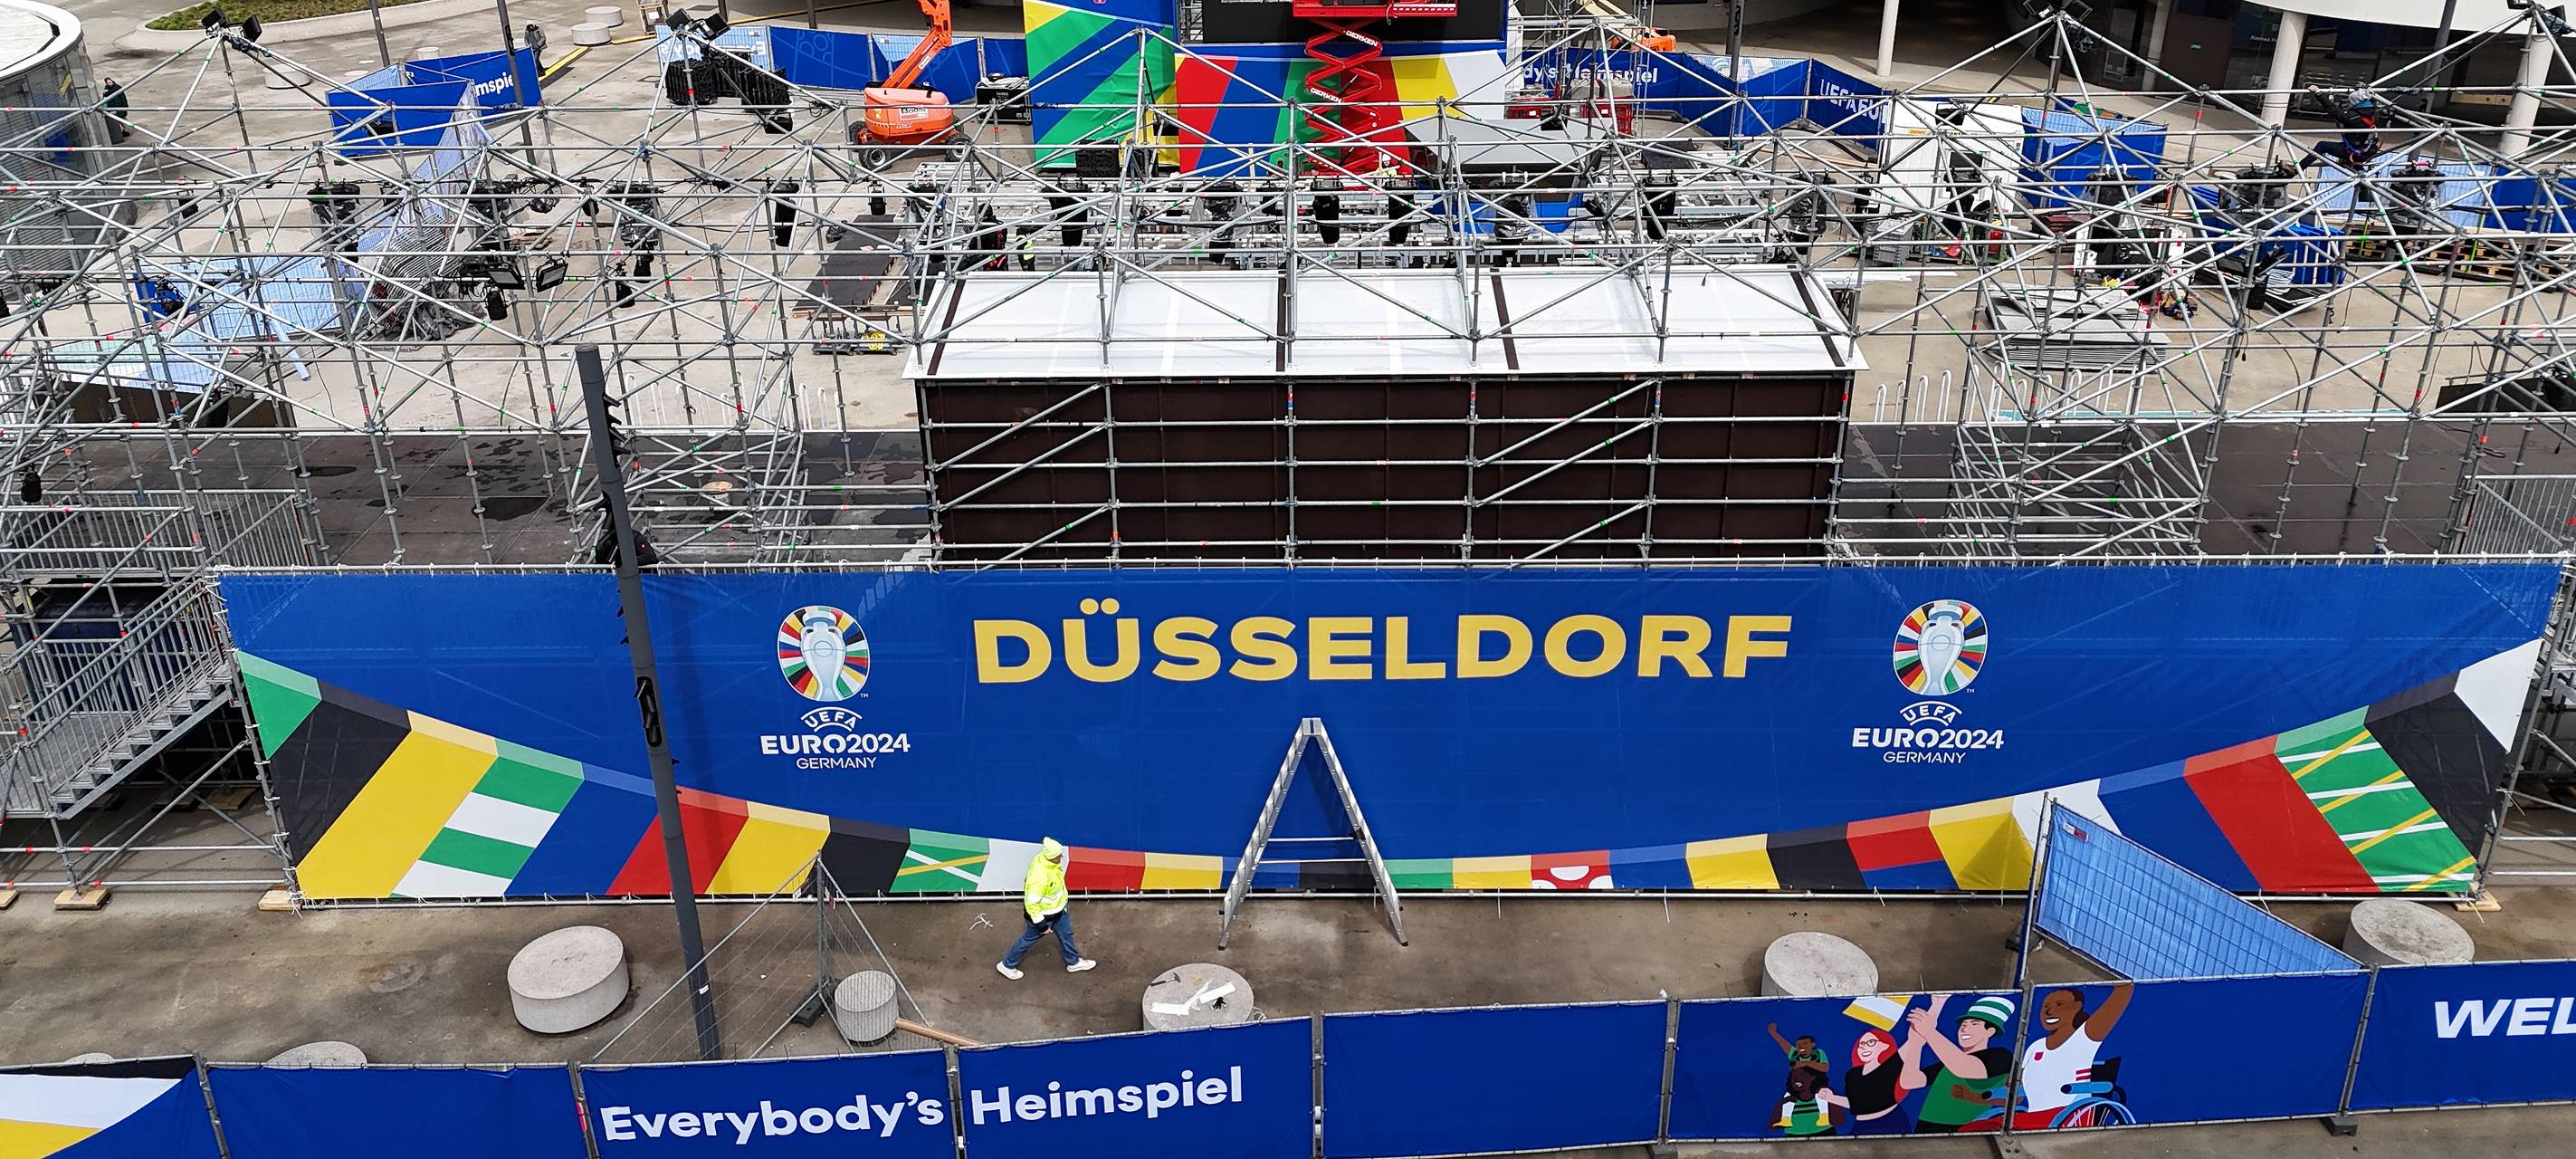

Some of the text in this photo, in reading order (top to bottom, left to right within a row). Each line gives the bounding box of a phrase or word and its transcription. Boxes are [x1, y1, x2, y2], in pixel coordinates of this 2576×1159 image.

[974, 599, 1791, 683] DÜSSELDORF
[804, 711, 857, 729] UEFA
[1903, 705, 1956, 723] UEFA
[760, 733, 911, 754] EURO2024
[1852, 728, 2005, 750] EURO2024
[796, 757, 877, 770] GERMANY
[1883, 752, 1967, 764] GERMANY
[2435, 998, 2576, 1038] WEL
[971, 1066, 1241, 1124] Heimspiel
